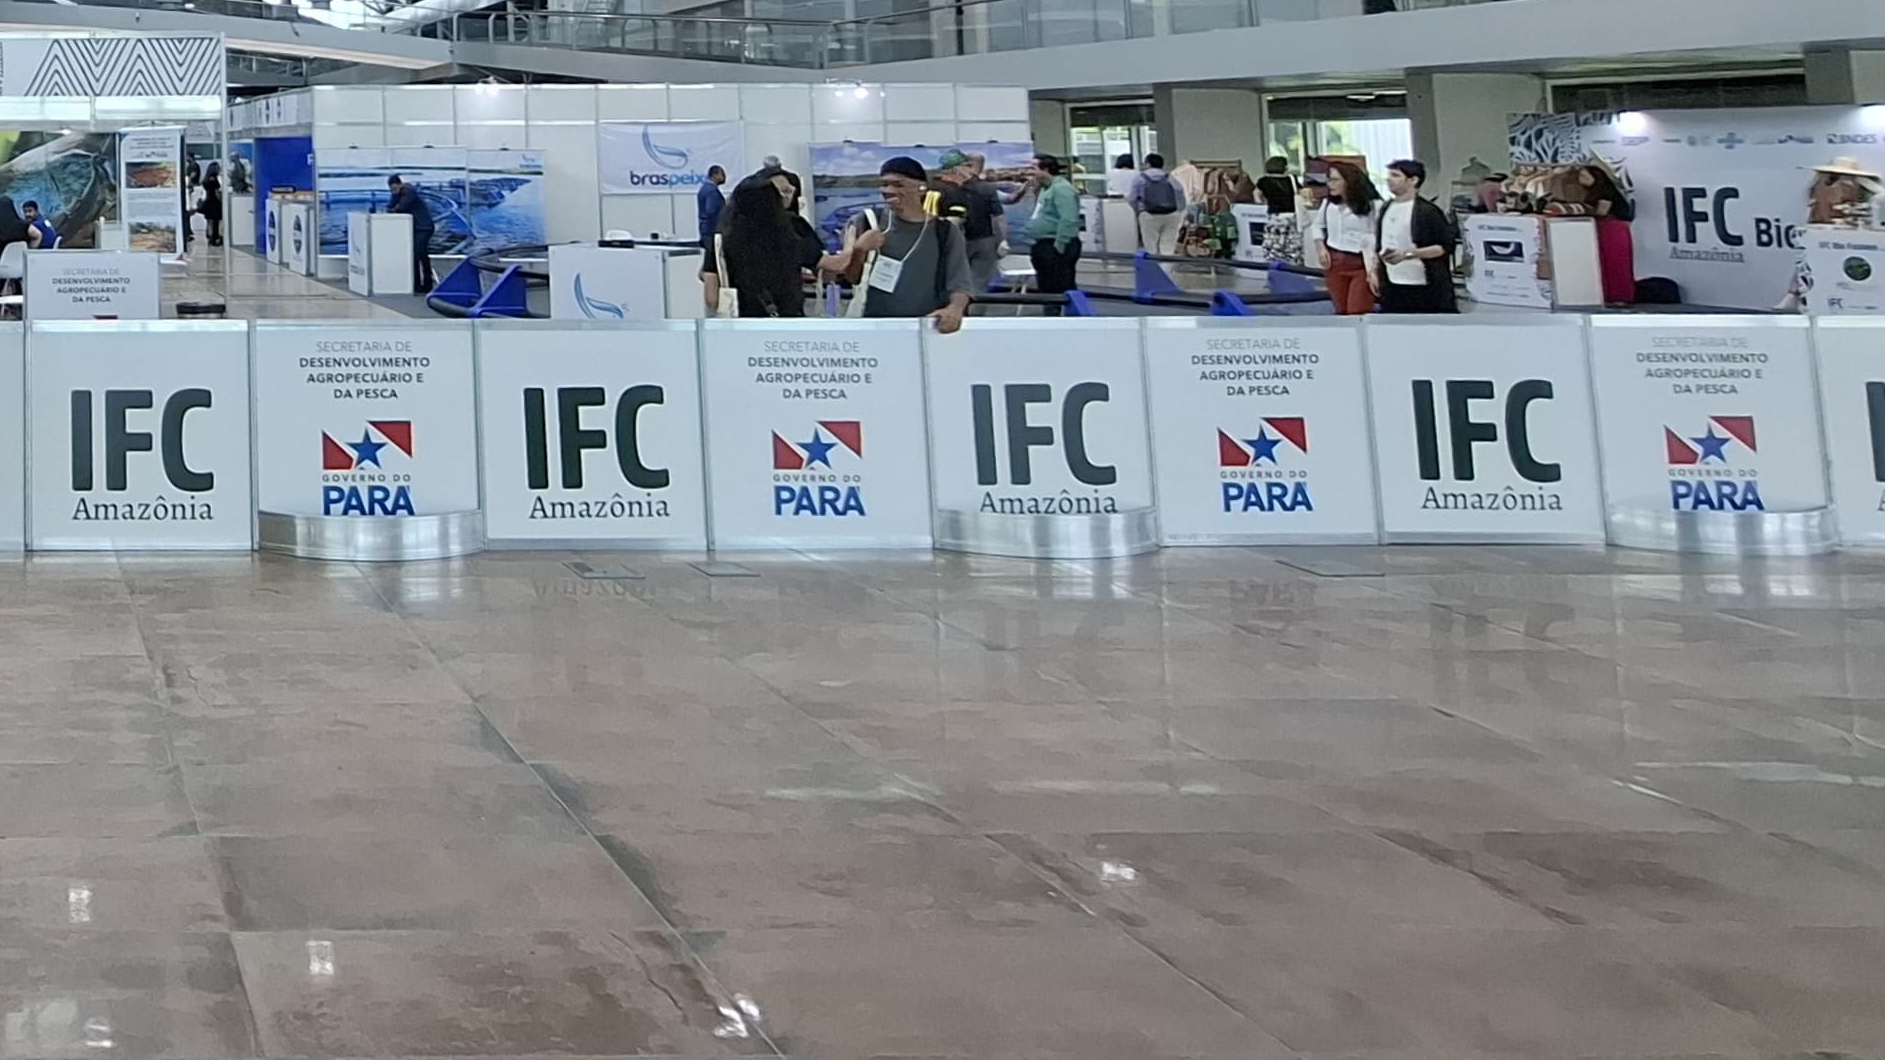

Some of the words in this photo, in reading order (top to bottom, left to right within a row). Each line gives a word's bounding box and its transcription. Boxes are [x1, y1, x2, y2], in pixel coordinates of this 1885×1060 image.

[629, 170, 709, 188] braspeix
[1664, 187, 1744, 247] IFC
[1670, 247, 1745, 263] Amazônia
[57, 285, 119, 294] AGROPECUÁRIO
[316, 341, 392, 353] SECRETARIA
[395, 341, 412, 352] DE
[764, 341, 840, 353] SECRETARIA
[843, 341, 860, 352] DE
[1207, 338, 1281, 350] SECRETARIA
[1284, 338, 1300, 349] DE
[1652, 337, 1728, 348] SECRETARIA
[1731, 337, 1748, 348] DE
[299, 357, 430, 368] DESENVOLVIMENTO
[748, 356, 878, 368] DESENVOLVIMENTO
[1191, 354, 1319, 365] DESENVOLVIMENTO
[1636, 352, 1768, 363] DESENVOLVIMENTO
[306, 370, 412, 383] AGROPECUÁRIO
[417, 373, 424, 383] E
[755, 371, 861, 383] AGROPECUÁRIO
[865, 373, 872, 383] E
[1199, 367, 1303, 381] AGROPECUÁRIO
[1307, 370, 1314, 379] E
[1645, 366, 1752, 379] AGROPECUÁRIO
[1755, 369, 1763, 378] E
[333, 389, 354, 399] DA
[356, 389, 398, 399] PESCA
[782, 389, 802, 399] DA
[805, 389, 847, 399] PESCA
[1226, 386, 1245, 396] DA
[1249, 385, 1290, 396] PESCA
[1673, 383, 1693, 394] DA
[1696, 383, 1738, 394] PESCA
[523, 384, 670, 490] IFC
[971, 382, 1117, 486] IFC
[1412, 379, 1562, 483] IFC
[71, 388, 214, 492] IFC
[322, 474, 386, 482] GOVERNO
[393, 474, 411, 482] DO
[773, 474, 836, 483] GOVERNO
[843, 475, 861, 483] DO
[1220, 470, 1282, 478] GOVERNO
[1289, 470, 1307, 478] DO
[1668, 469, 1733, 477] GOVERNO
[1739, 469, 1757, 477] DO
[980, 489, 1118, 514] Amazônia
[1421, 485, 1563, 511] Amazônia
[72, 495, 215, 521] Amazônia
[529, 492, 670, 519] Amazônia
